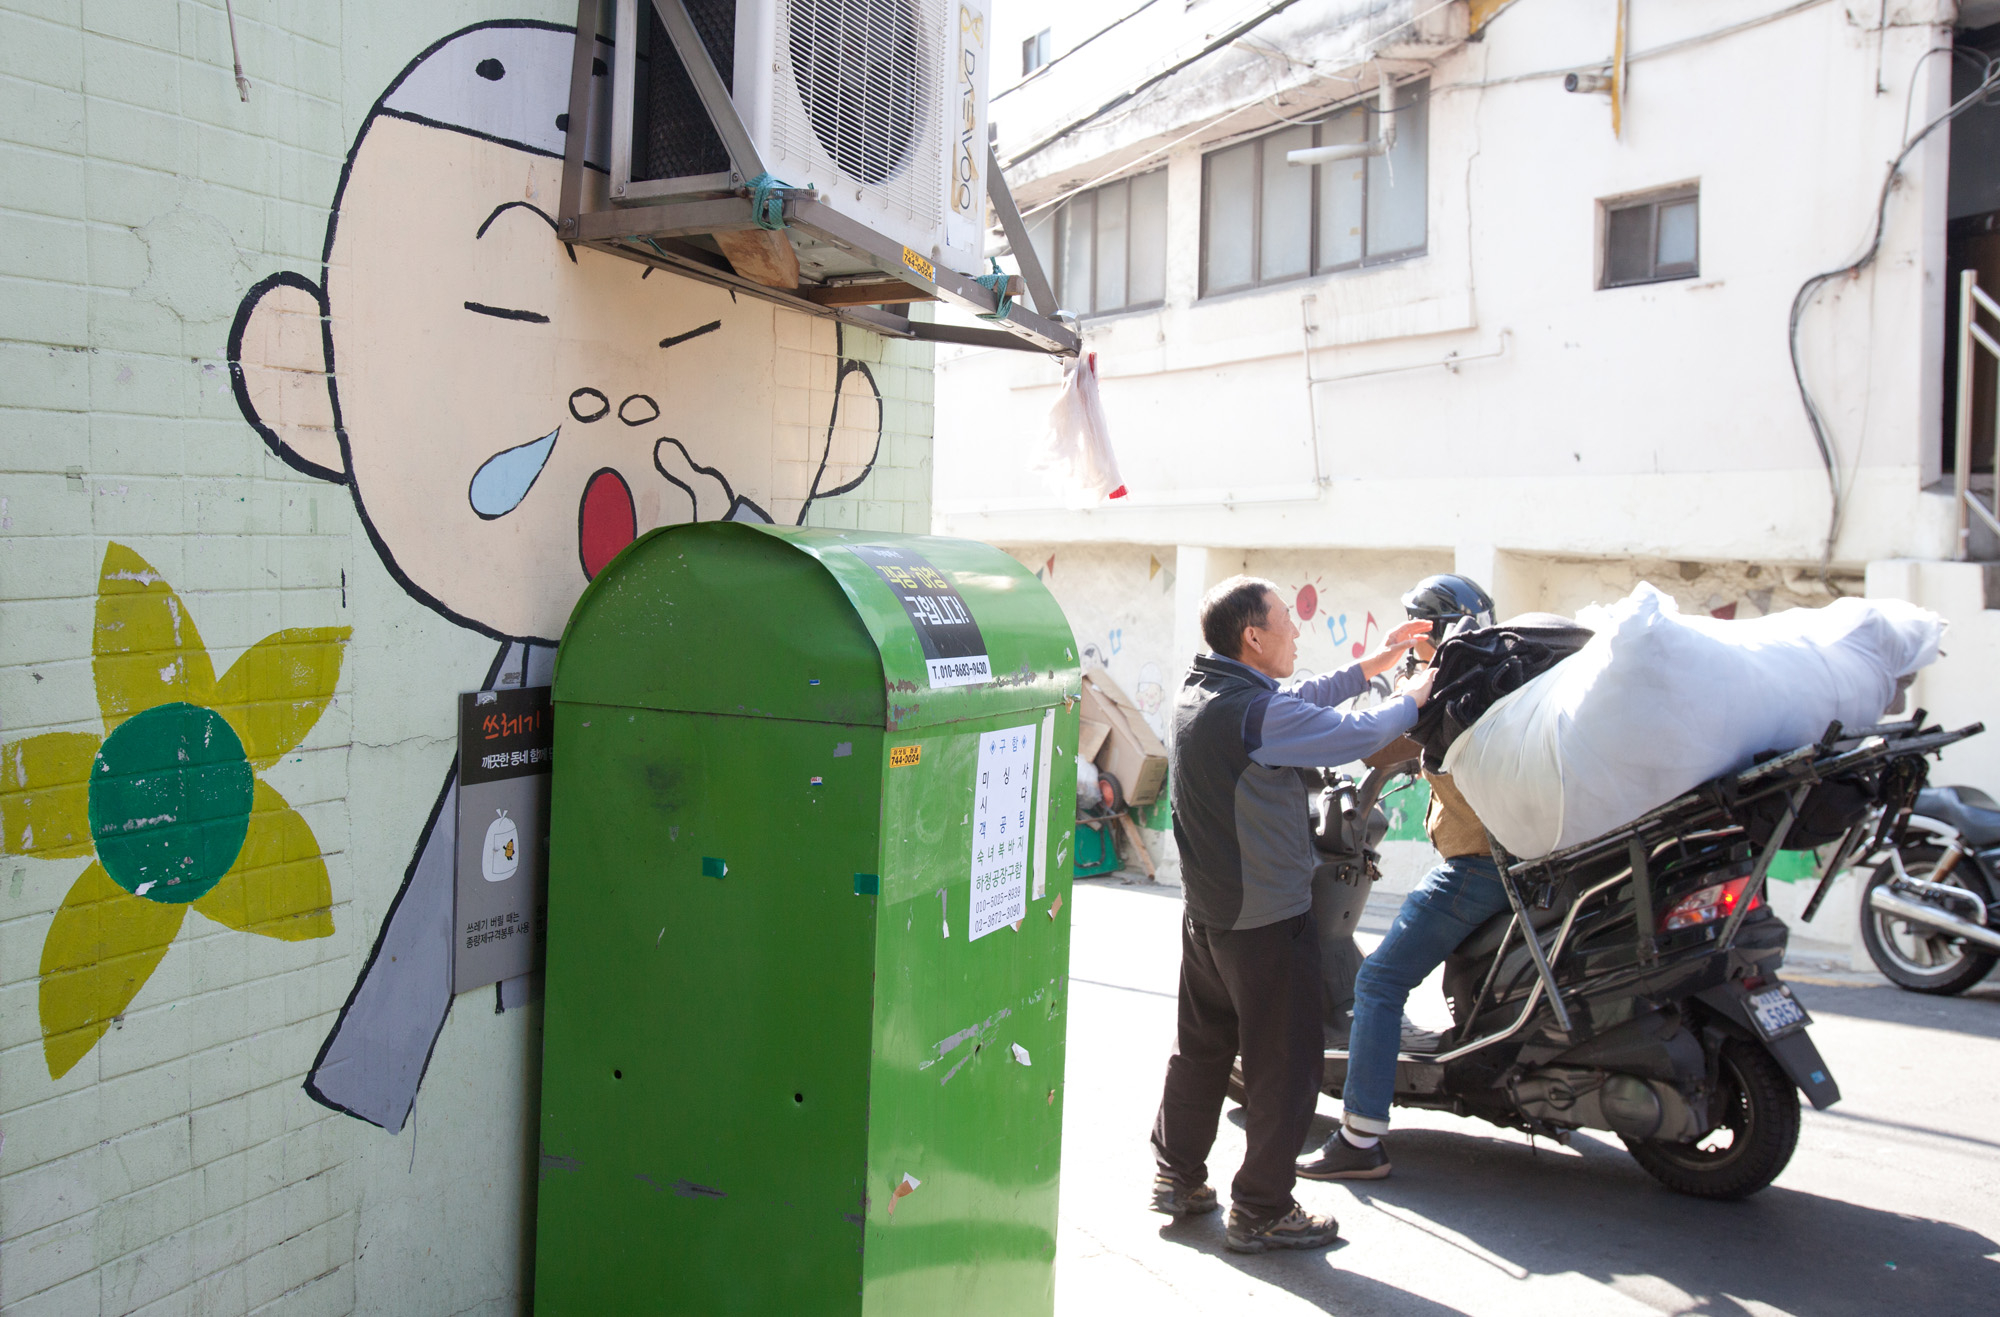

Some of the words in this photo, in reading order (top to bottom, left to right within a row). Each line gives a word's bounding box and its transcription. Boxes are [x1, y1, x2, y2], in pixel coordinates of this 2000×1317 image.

[958, 48, 976, 210] DAEWOO
[904, 253, 932, 279] 744-0024
[904, 594, 970, 626] 구합니다!
[482, 710, 540, 740] 쓰레기
[999, 735, 1019, 755] 구함
[481, 752, 510, 770] 깨끗한
[510, 749, 529, 766] 동네
[891, 753, 919, 766] 744-0024
[466, 918, 488, 934] 쓰레기
[516, 921, 530, 934] 사용
